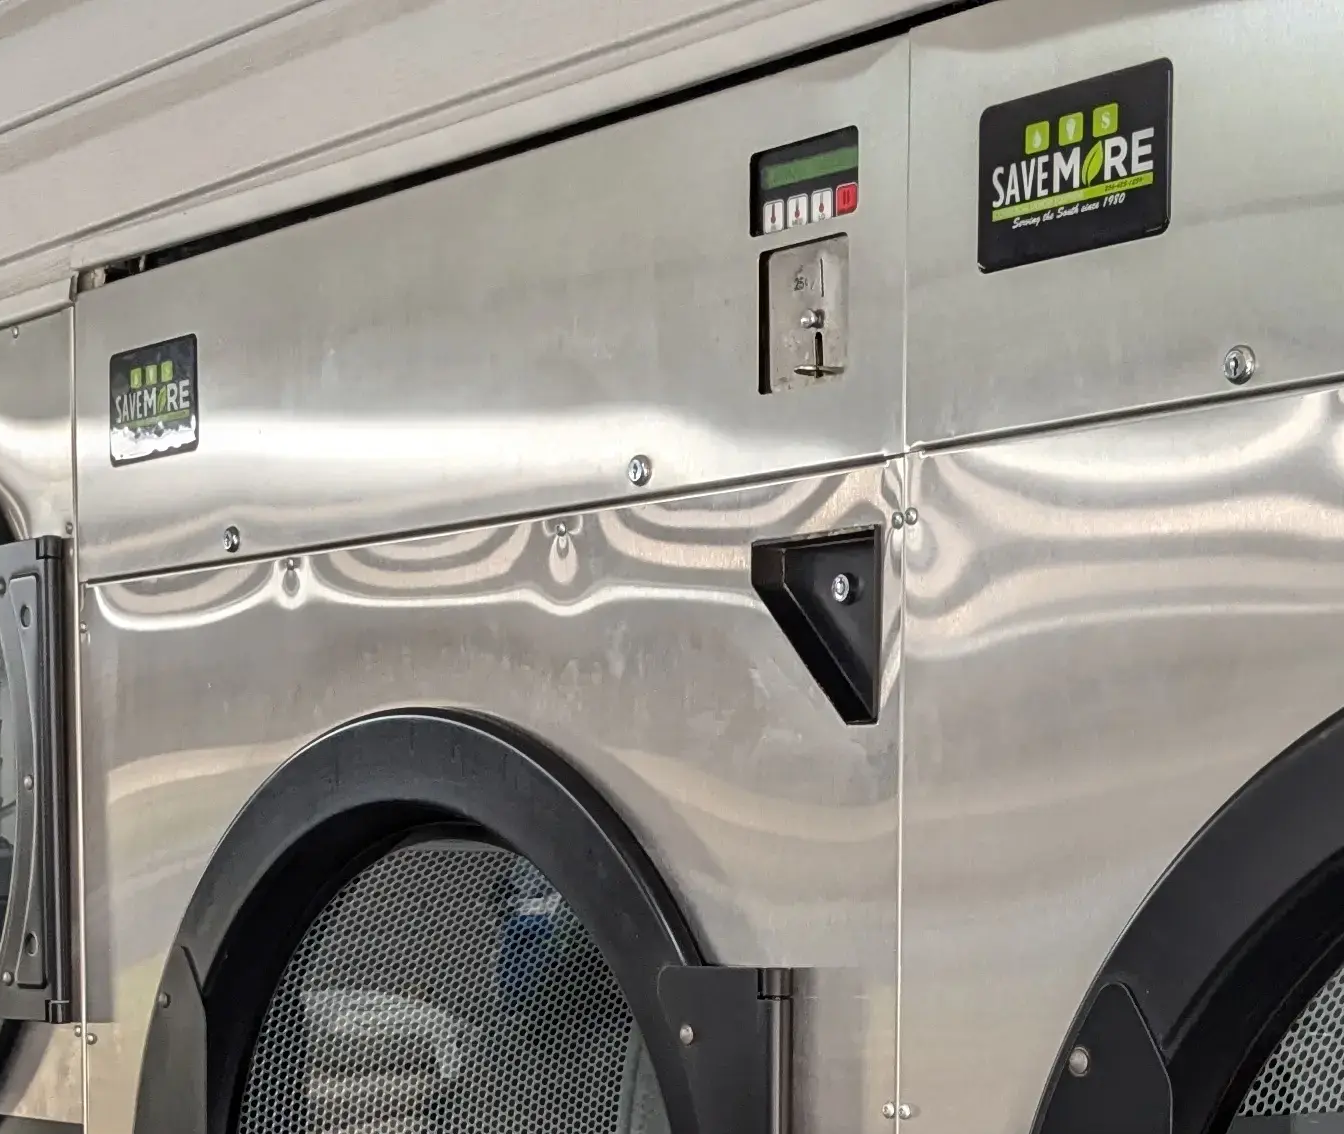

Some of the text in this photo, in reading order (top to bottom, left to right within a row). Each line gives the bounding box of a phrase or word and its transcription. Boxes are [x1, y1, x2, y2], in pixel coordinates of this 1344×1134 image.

[1012, 192, 1126, 230] Serving the South since 1980
